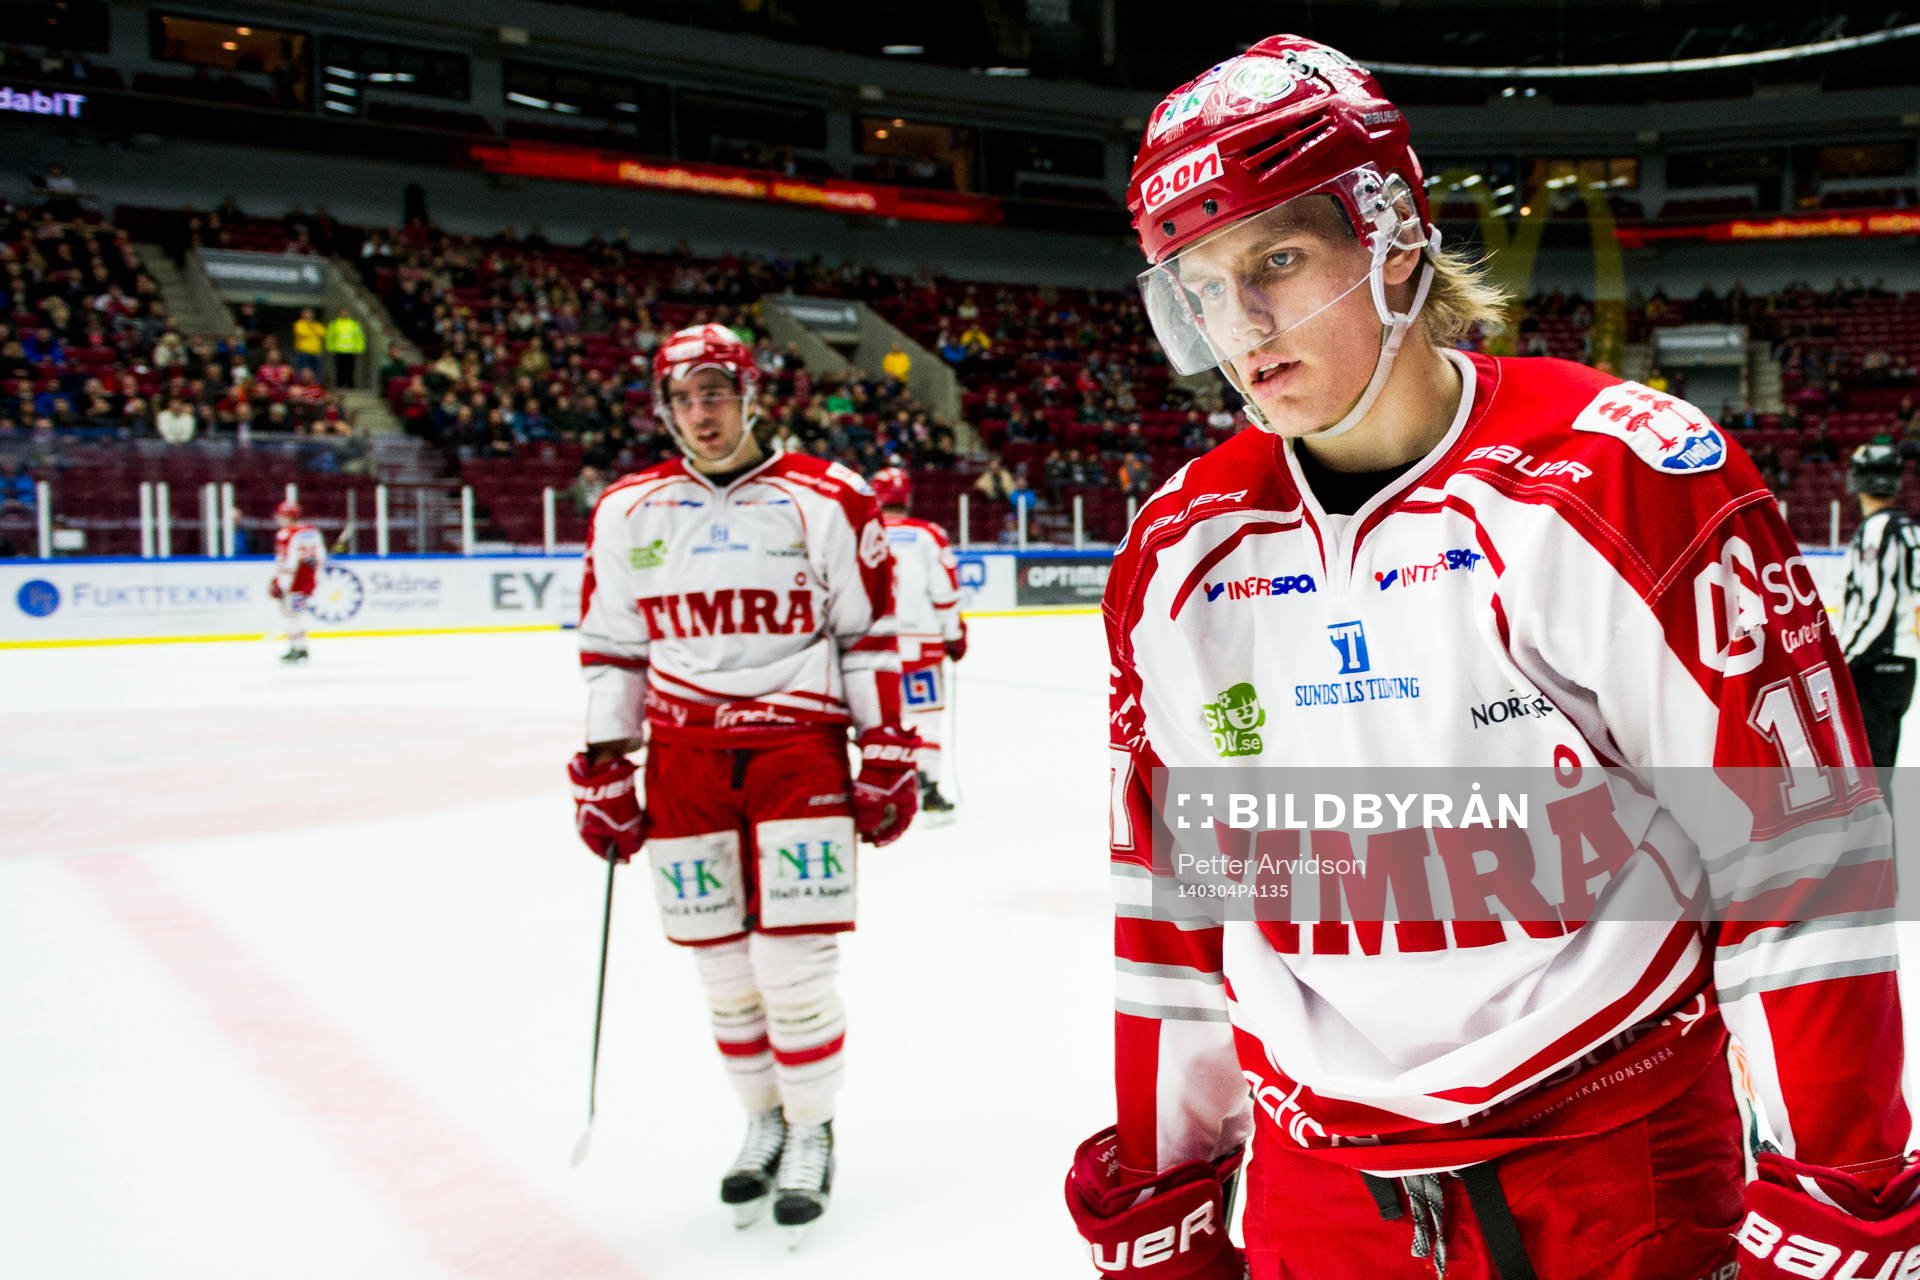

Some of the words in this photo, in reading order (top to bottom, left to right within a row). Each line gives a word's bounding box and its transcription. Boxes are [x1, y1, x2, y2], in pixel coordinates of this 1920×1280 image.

[1463, 445, 1593, 484] BAUER
[491, 572, 555, 611] EY
[637, 572, 815, 642] TIMRÅ
[1747, 661, 1862, 816] 17
